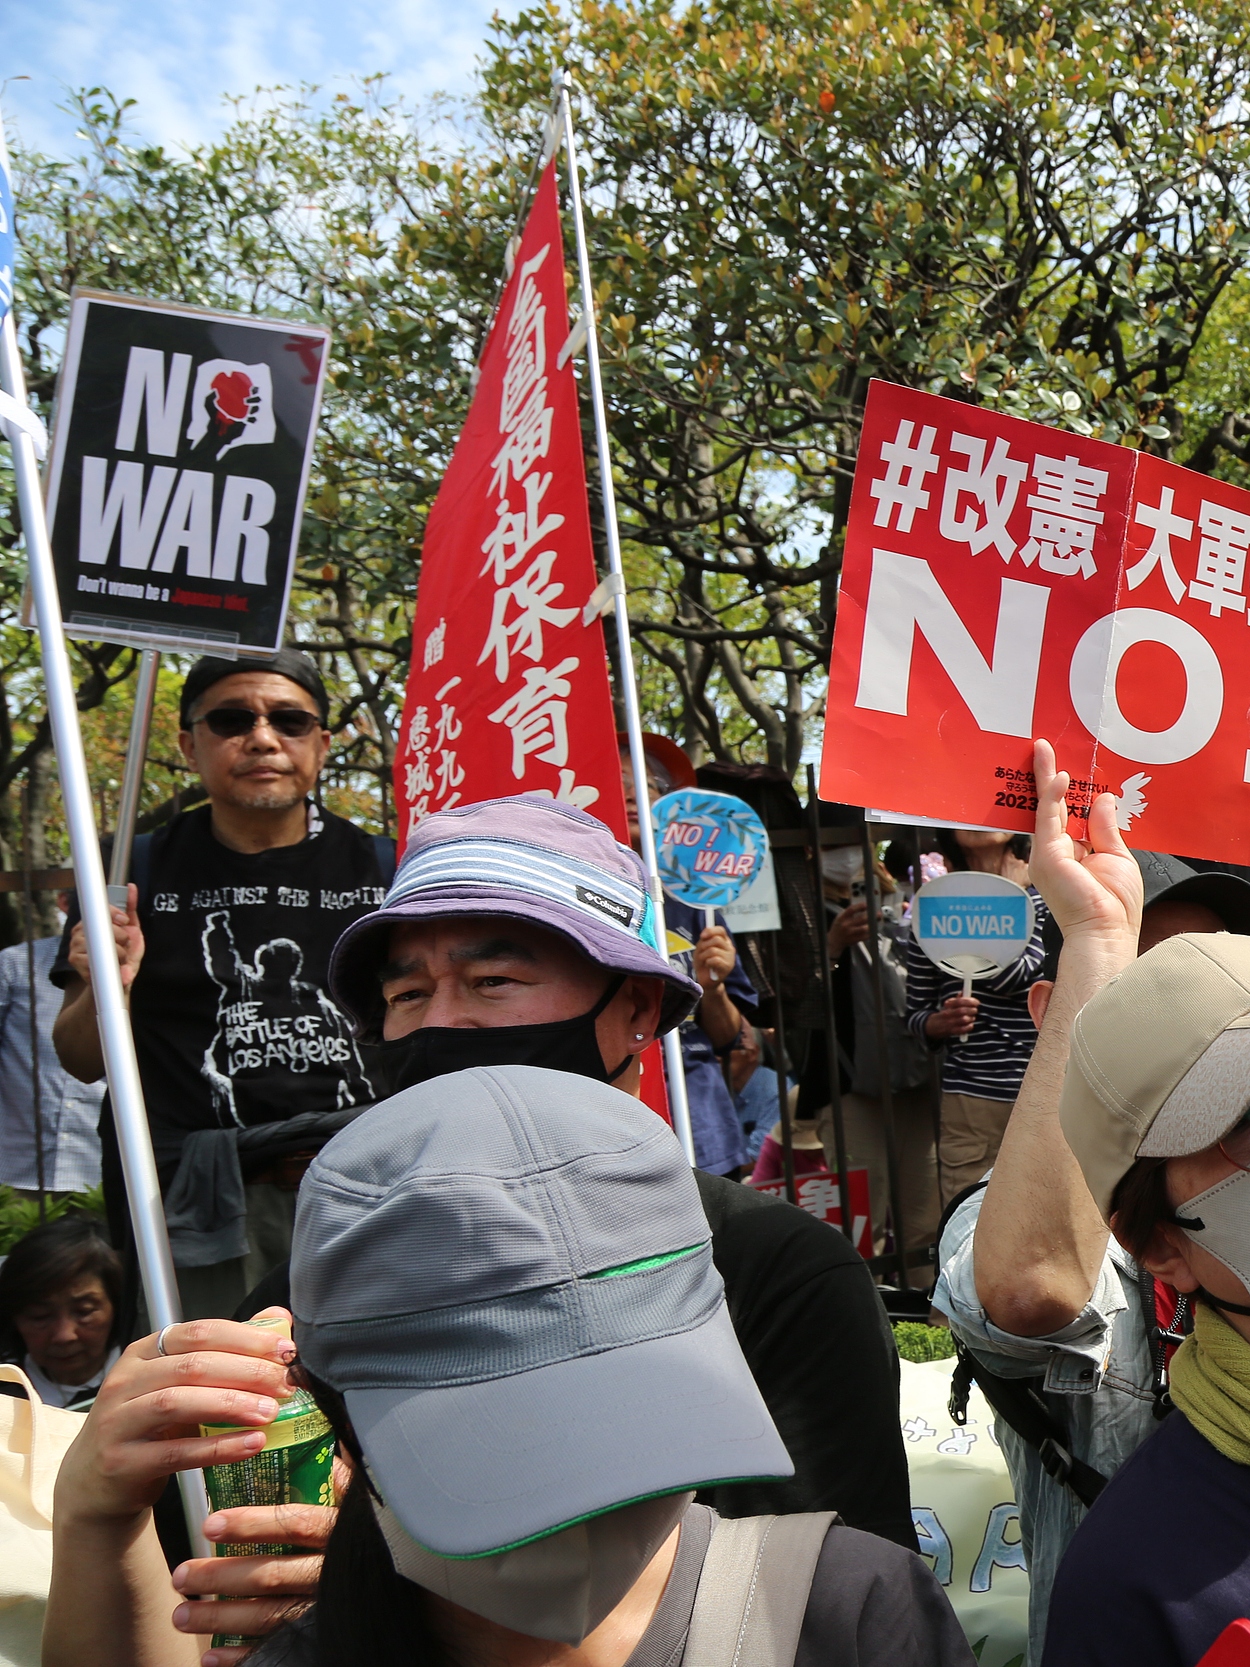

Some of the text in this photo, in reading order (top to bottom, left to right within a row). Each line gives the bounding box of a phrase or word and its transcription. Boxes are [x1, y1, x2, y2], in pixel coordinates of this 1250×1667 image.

[870, 419, 1109, 580] #改憲
[79, 455, 276, 585] WAR
[77, 574, 107, 594] Don't
[108, 581, 144, 599] wanna
[145, 583, 160, 601] be
[161, 588, 170, 602] a
[433, 676, 465, 811] 一九九
[694, 849, 755, 877] WAR
[153, 886, 387, 912] GE AGAINST THE MACHIN
[594, 896, 628, 918] Columbia
[931, 915, 1015, 935] NO WAR
[222, 1001, 263, 1025] THE
[226, 1015, 322, 1048] BATTLE OF
[228, 1049, 263, 1076] LOS
